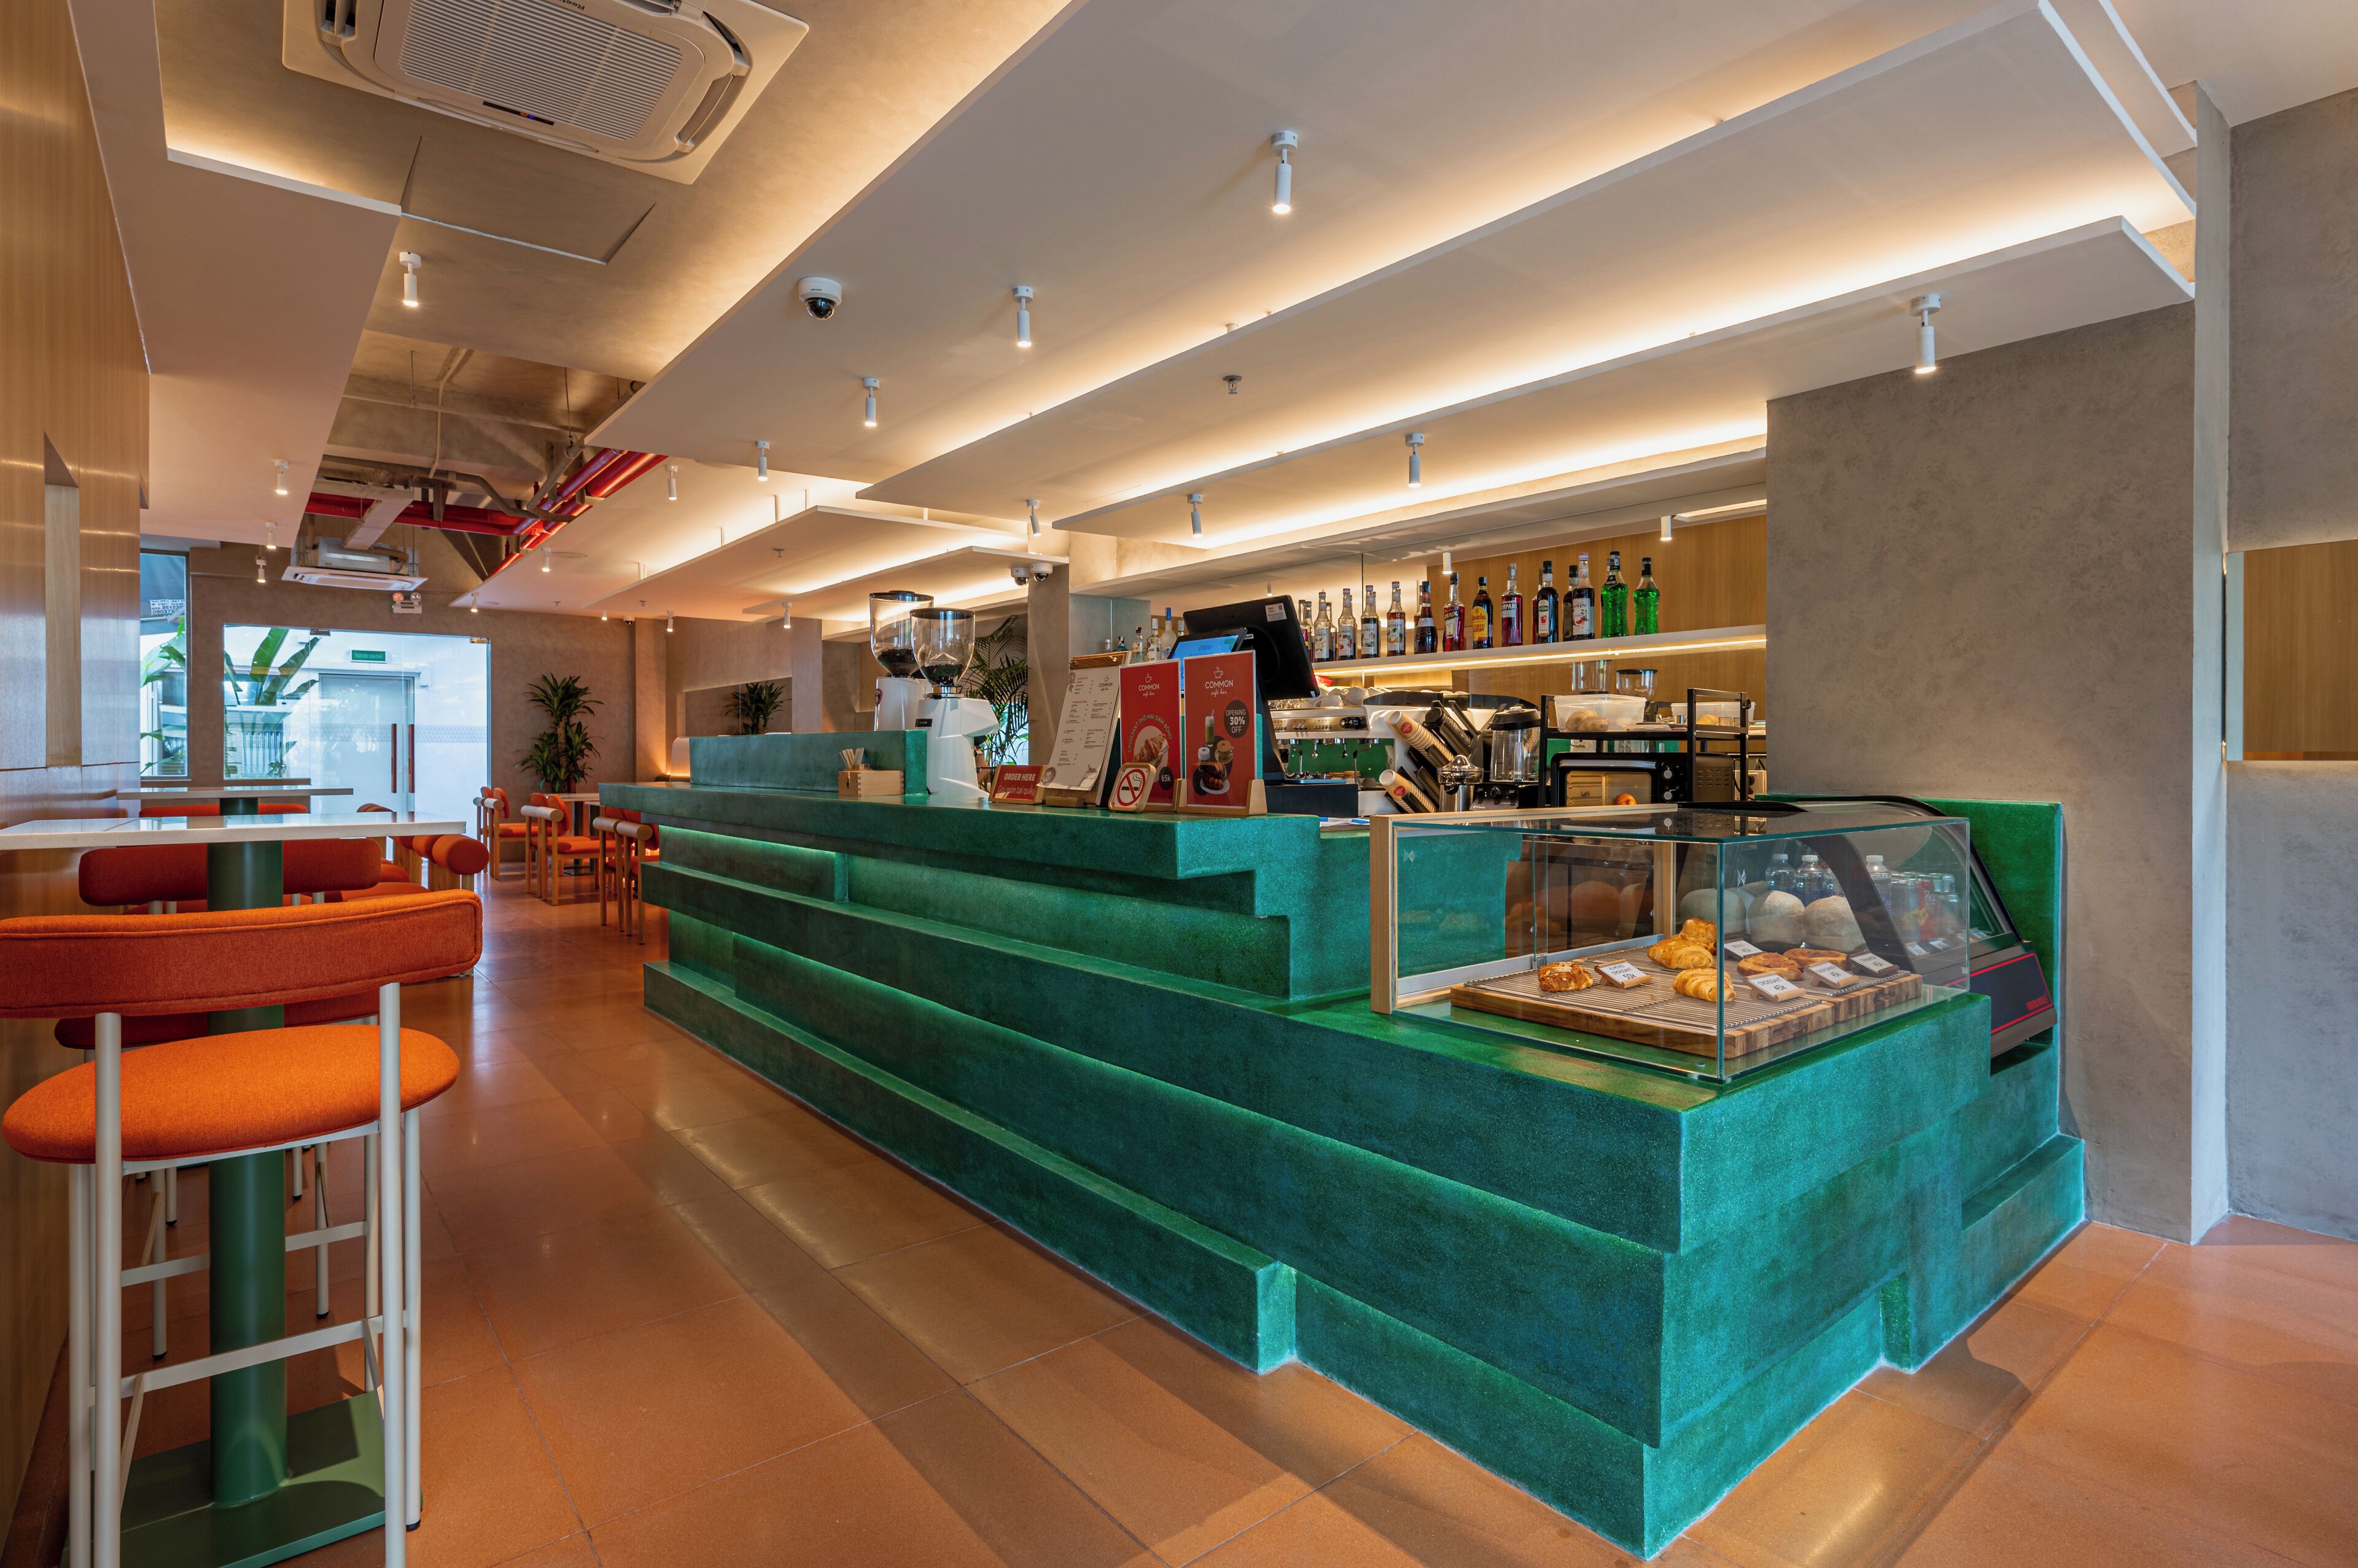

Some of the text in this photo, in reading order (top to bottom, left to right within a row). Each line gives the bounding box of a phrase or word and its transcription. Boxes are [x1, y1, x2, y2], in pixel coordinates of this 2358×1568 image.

[1205, 679, 1234, 689] COMMON
[1210, 689, 1219, 697] café
[1230, 716, 1245, 725] 30%
[1757, 977, 1781, 986] CROISSANT
